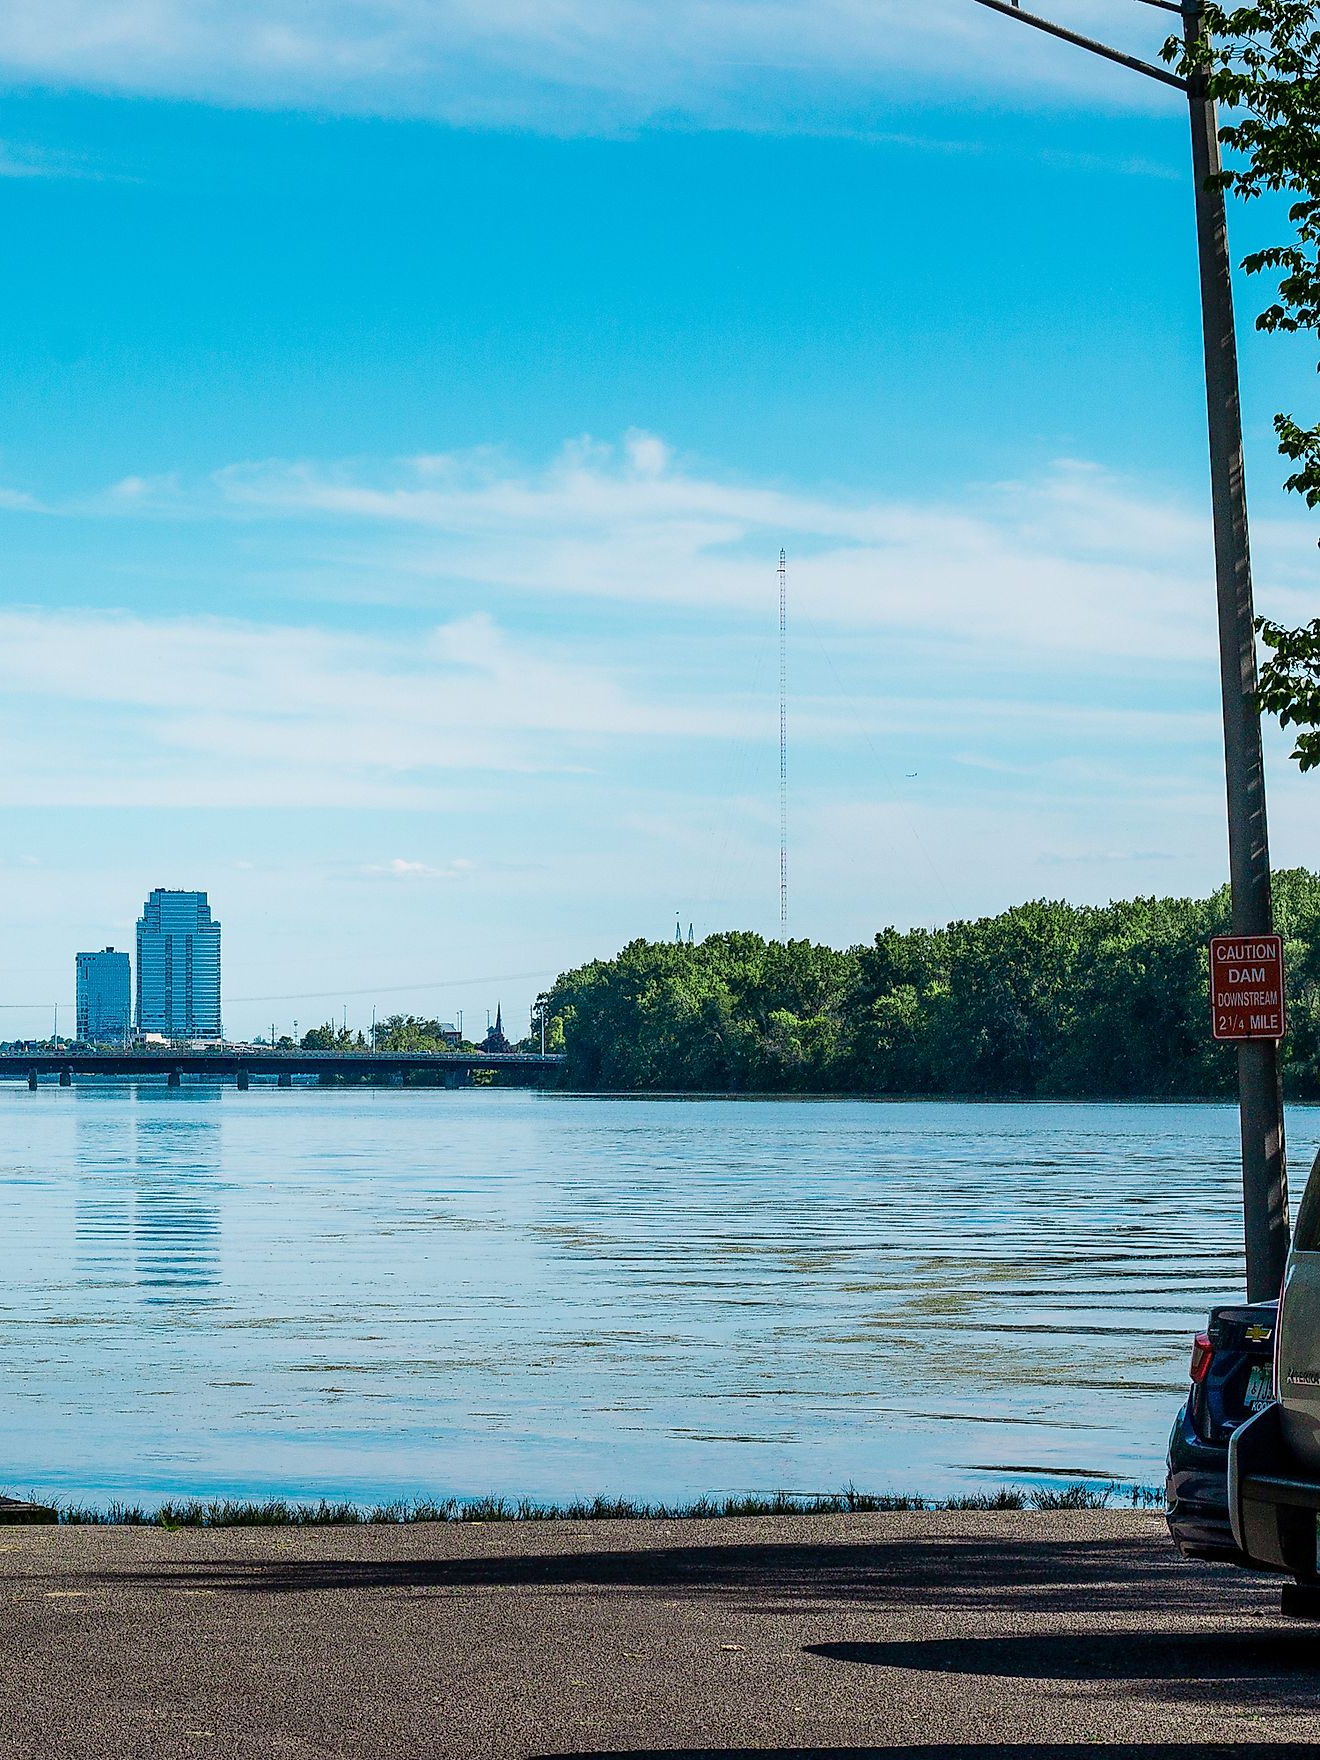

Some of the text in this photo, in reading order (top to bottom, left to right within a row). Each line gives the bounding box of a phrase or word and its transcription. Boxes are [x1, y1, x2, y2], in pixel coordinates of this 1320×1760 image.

[1216, 944, 1276, 960] CAUTION
[1228, 968, 1266, 983] DAM
[1218, 991, 1278, 1007] DOWNSTREAM
[1250, 1014, 1278, 1030] MILE
